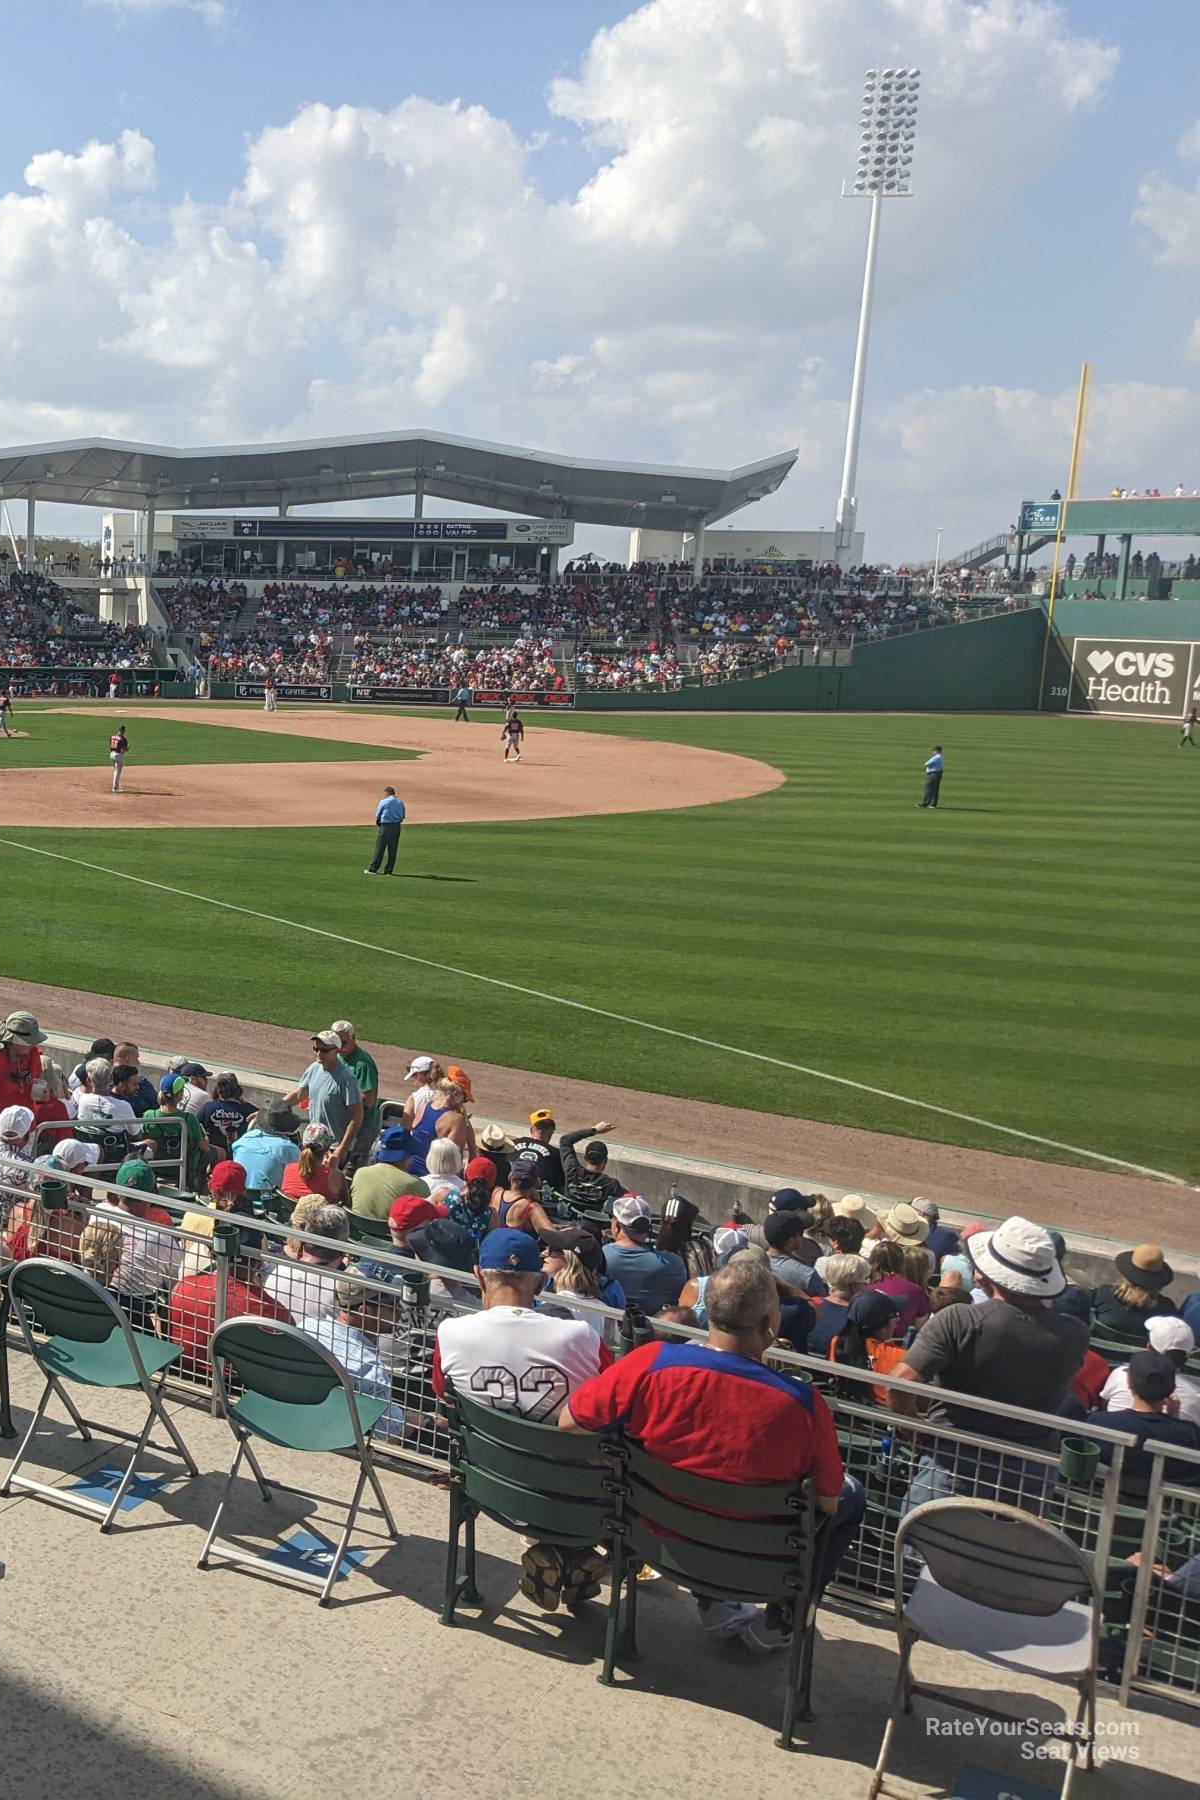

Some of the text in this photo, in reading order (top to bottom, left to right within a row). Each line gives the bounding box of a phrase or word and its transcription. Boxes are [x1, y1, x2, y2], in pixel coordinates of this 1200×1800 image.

[1114, 651, 1175, 678] CVS
[249, 687, 283, 695] PERCT
[475, 692, 501, 700] DEX
[1050, 686, 1068, 697] 310
[1086, 677, 1171, 705] Health
[509, 693, 536, 702] DEX
[543, 694, 570, 703] DEX
[216, 1109, 239, 1119] Coors
[470, 1366, 569, 1421] 32
